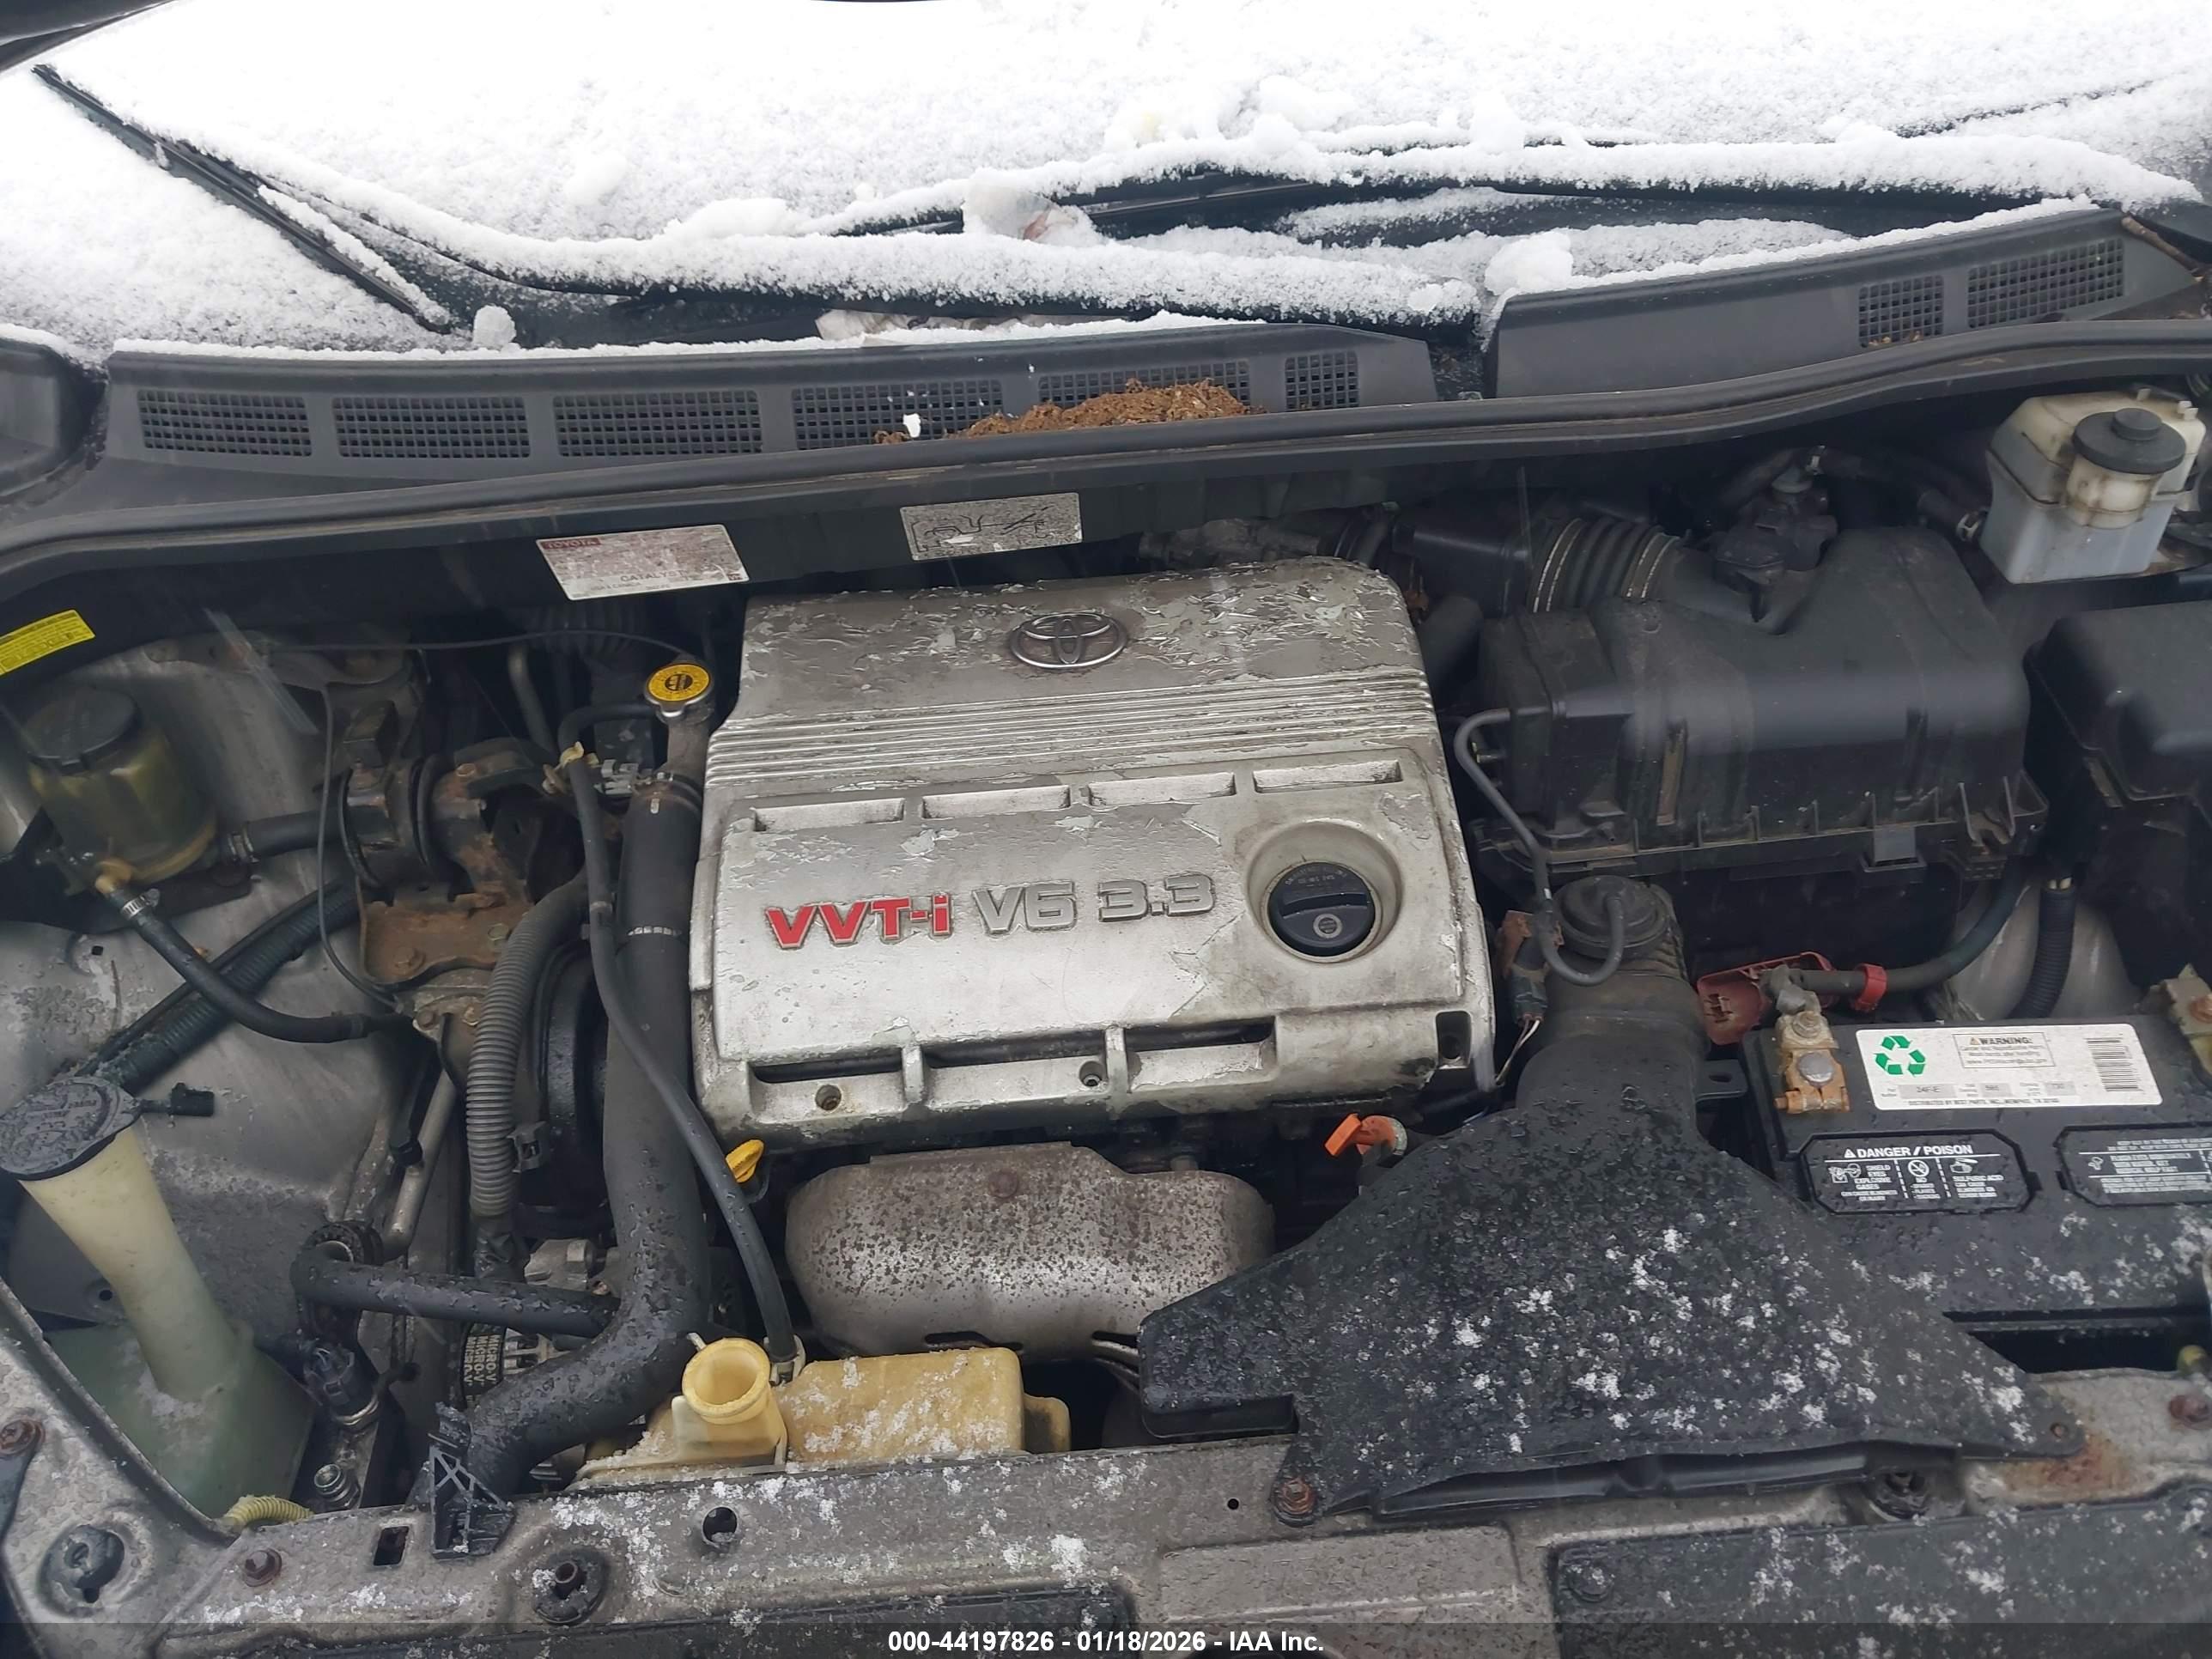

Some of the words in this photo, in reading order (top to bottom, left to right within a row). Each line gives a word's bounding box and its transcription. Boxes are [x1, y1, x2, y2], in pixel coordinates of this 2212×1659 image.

[546, 539, 596, 549] TOYOTA
[765, 893, 951, 950] VVT-i
[972, 879, 1078, 934] V6
[1097, 872, 1217, 921] 3.3
[1979, 1036, 2033, 1045] WARNING:
[1857, 1147, 1911, 1158] DANGER
[1912, 1146, 1922, 1156] /
[1923, 1145, 1974, 1155] POISON
